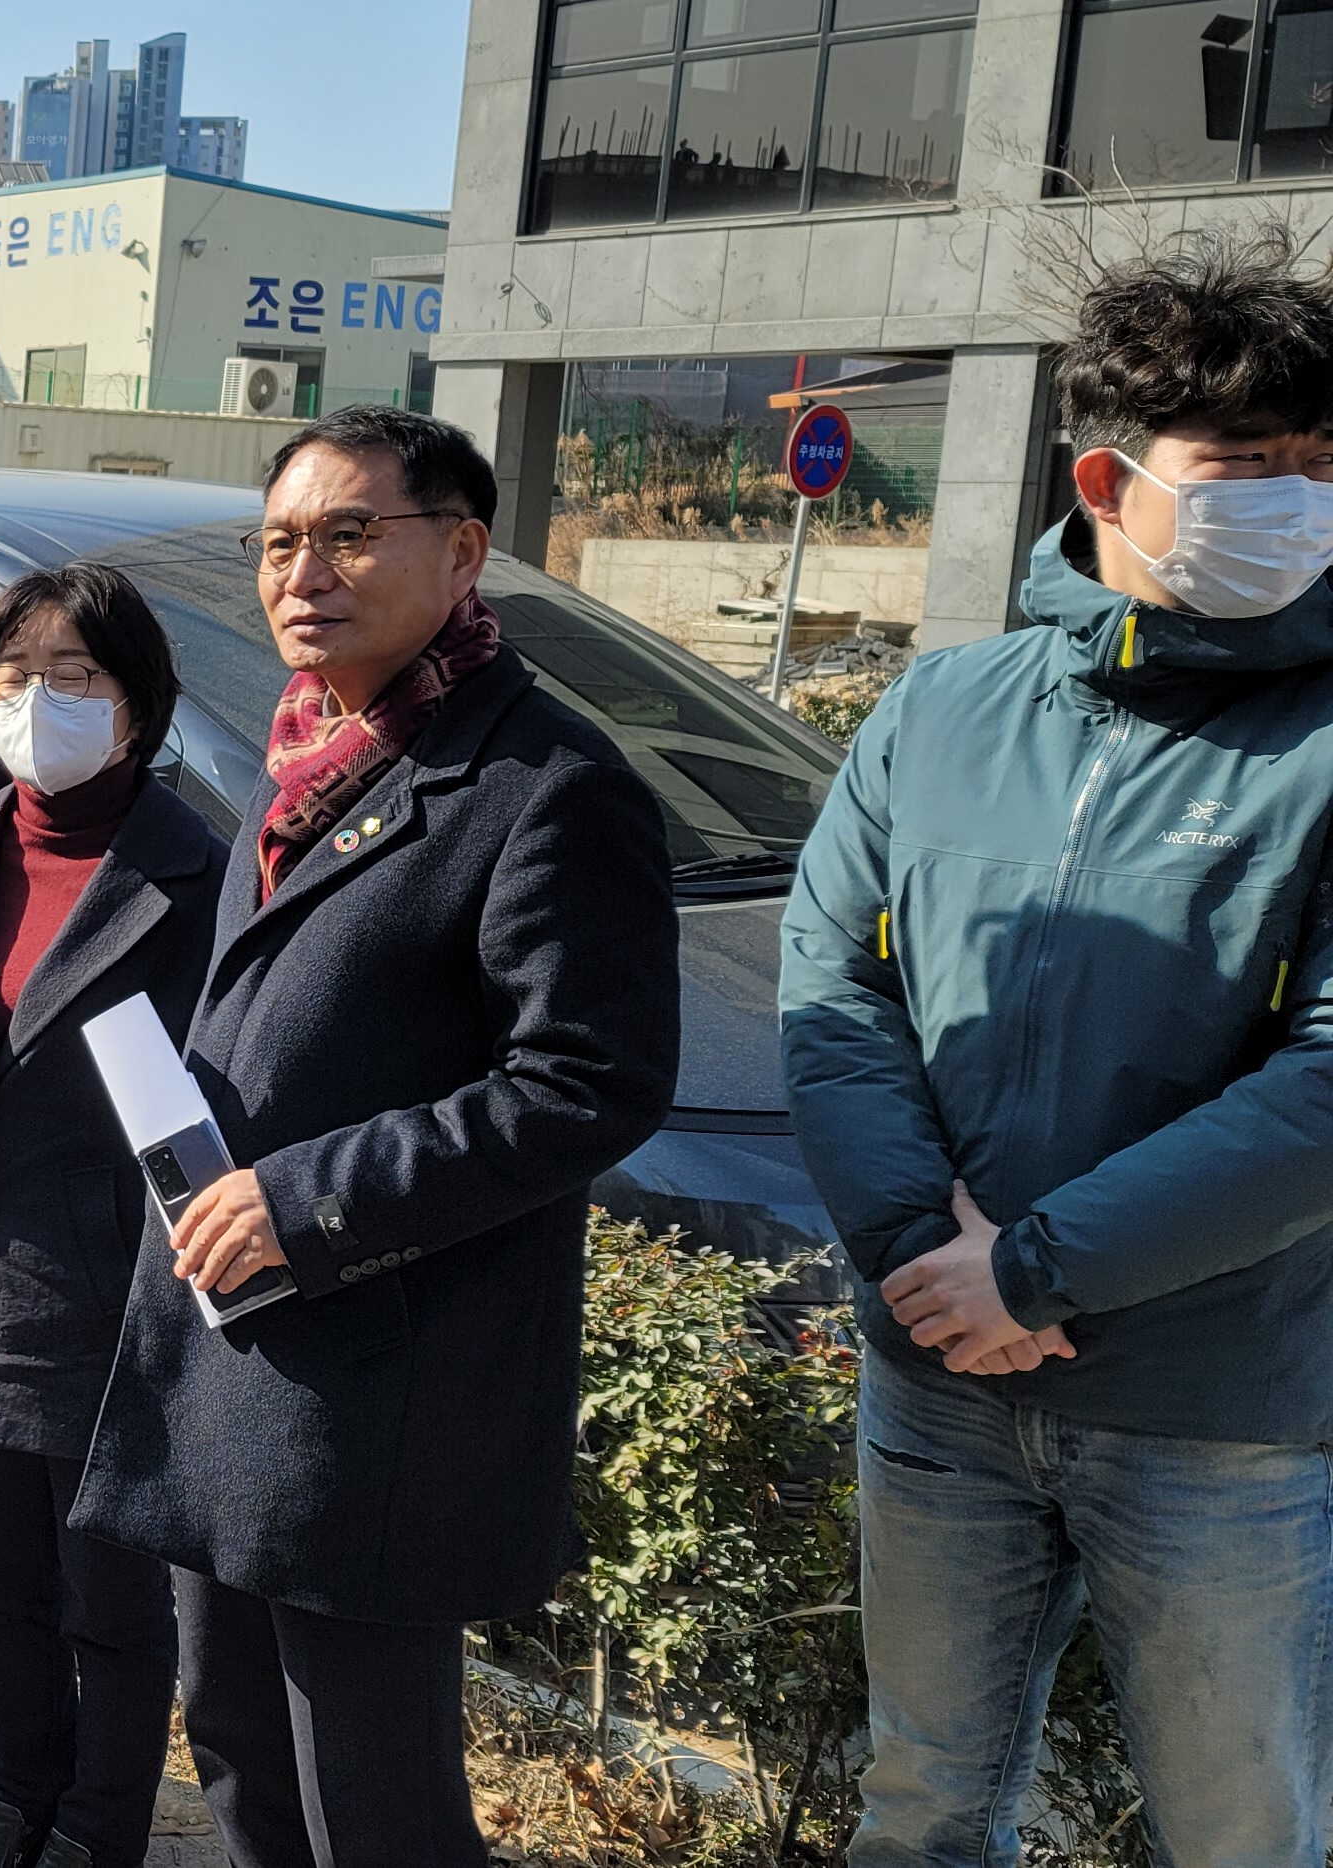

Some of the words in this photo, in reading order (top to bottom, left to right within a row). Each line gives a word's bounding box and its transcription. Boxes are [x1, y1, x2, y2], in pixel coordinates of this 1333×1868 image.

[47, 203, 122, 257] ENG
[244, 276, 325, 334] 조은
[341, 282, 442, 334] ENG
[799, 444, 844, 460] 주정차금지
